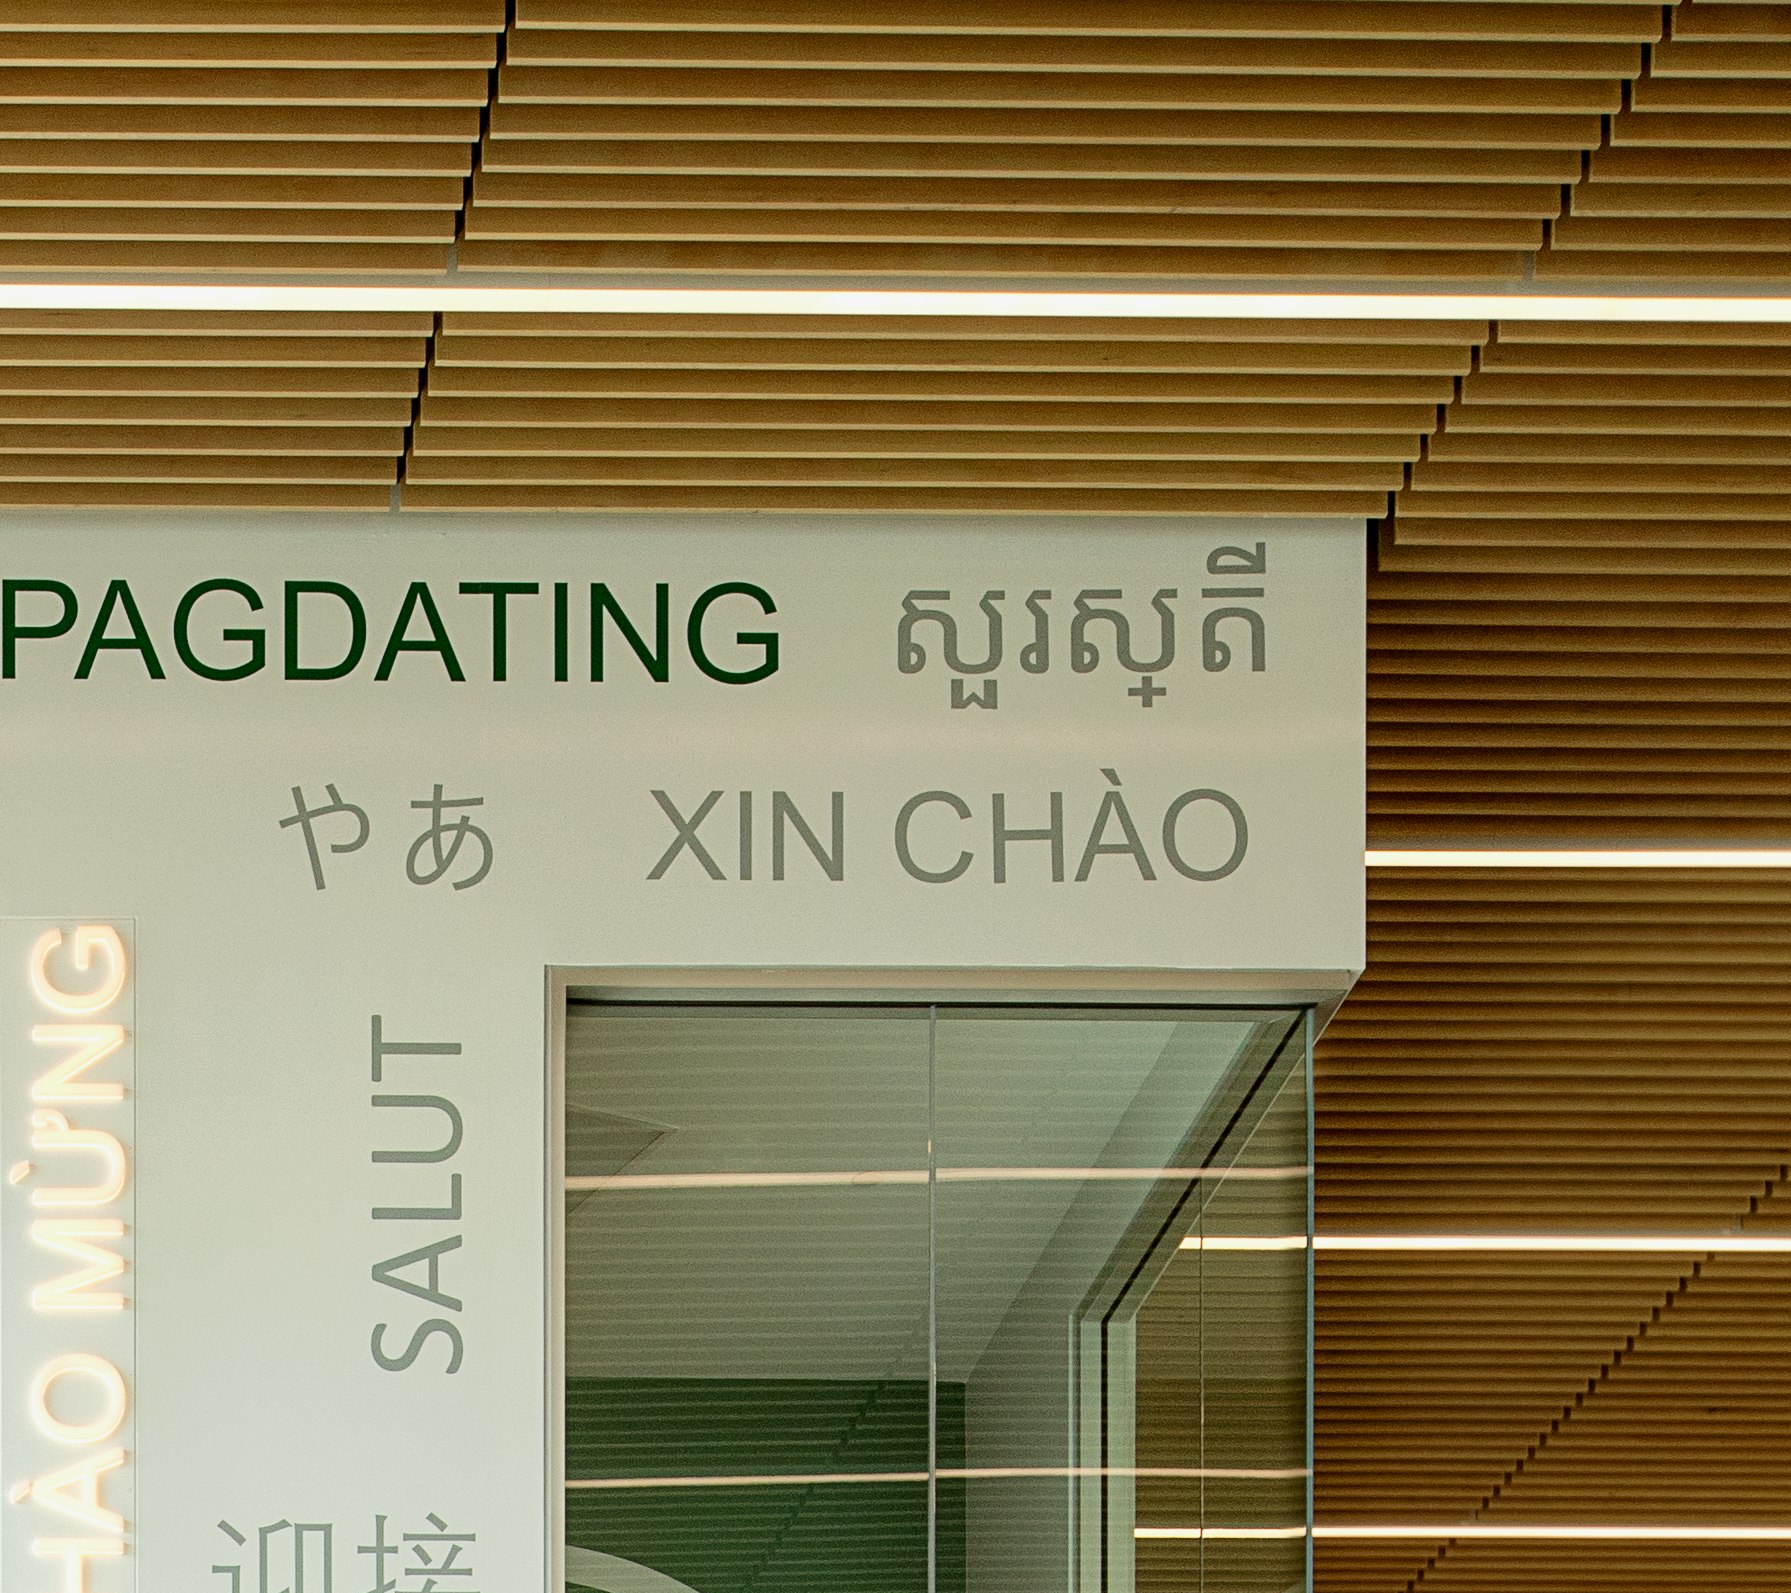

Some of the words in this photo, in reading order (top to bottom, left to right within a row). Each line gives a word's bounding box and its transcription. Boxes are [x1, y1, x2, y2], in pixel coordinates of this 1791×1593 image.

[3, 579, 778, 684] PAGDATING
[279, 784, 495, 890] やあ
[647, 790, 843, 881] XIN
[895, 769, 1248, 883] CHÀO
[8, 922, 130, 1315] MỪNG
[371, 1015, 463, 1374] SALUT
